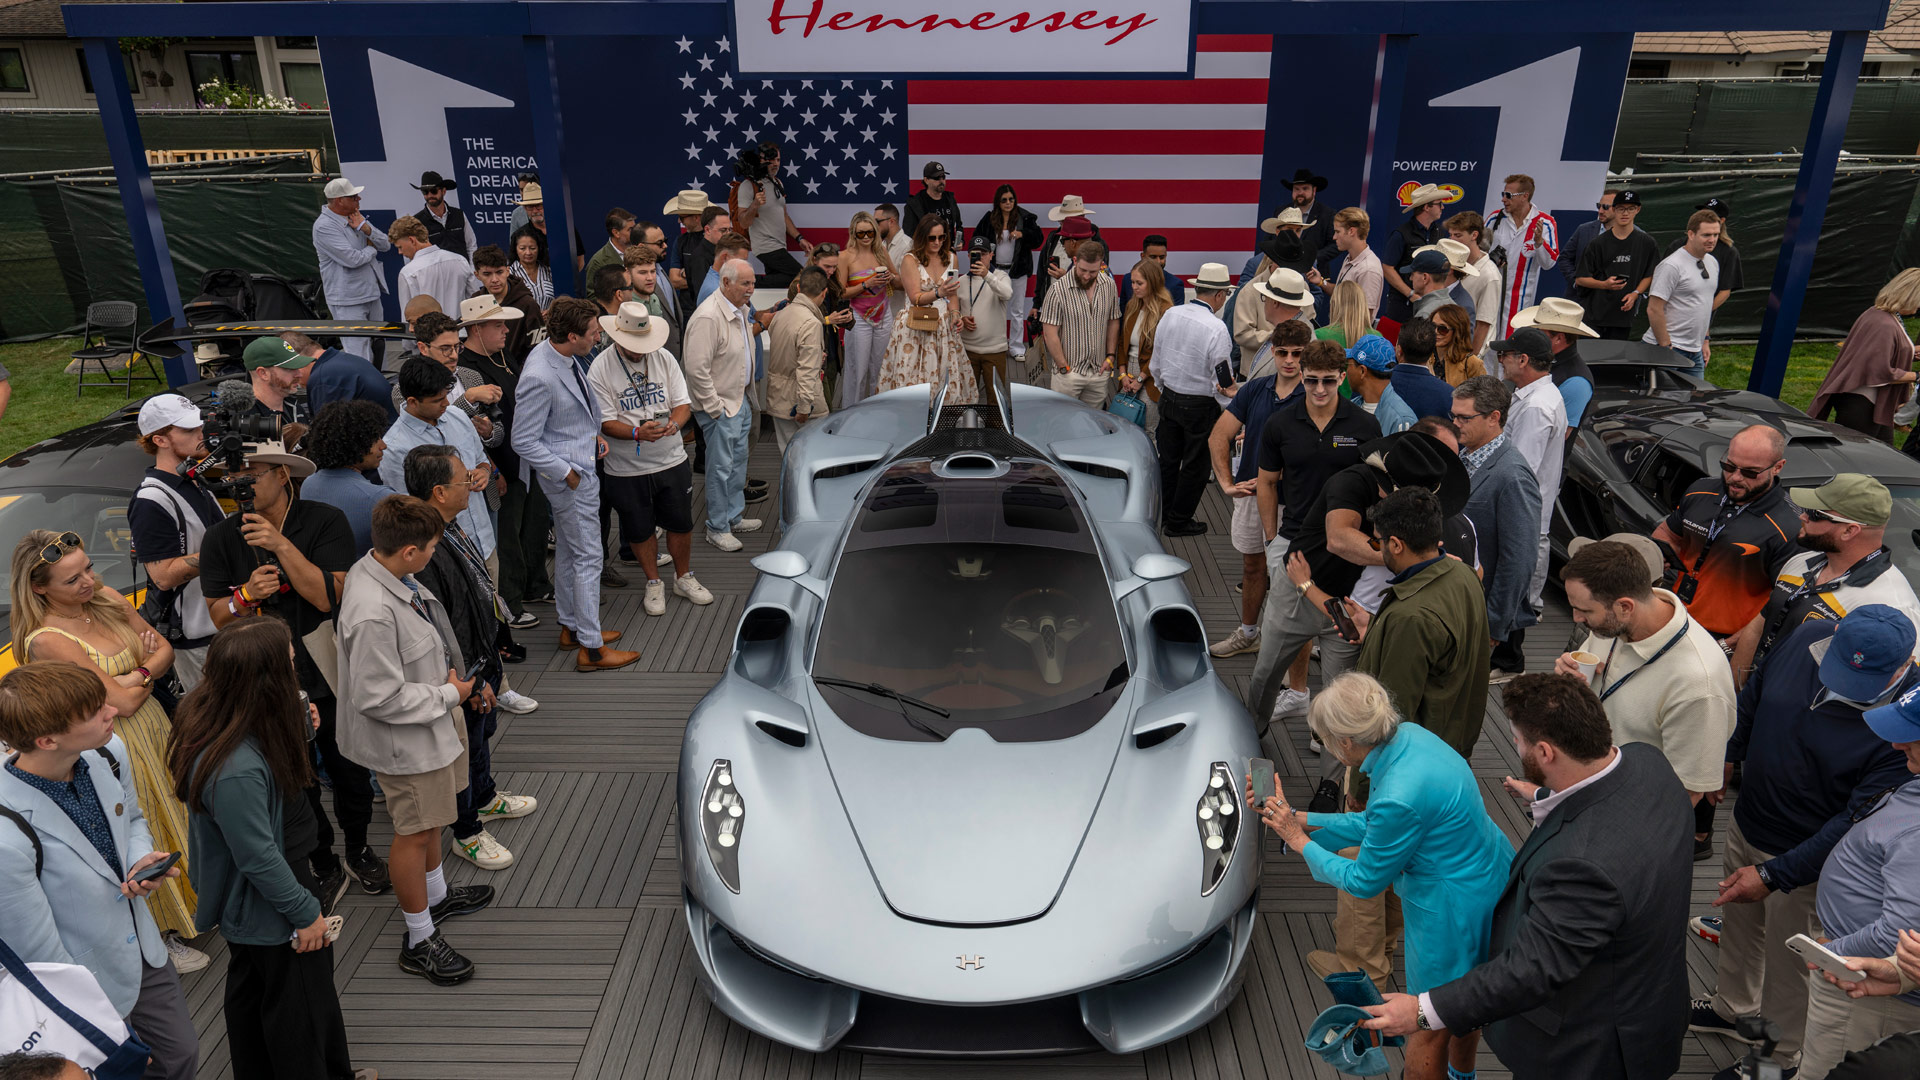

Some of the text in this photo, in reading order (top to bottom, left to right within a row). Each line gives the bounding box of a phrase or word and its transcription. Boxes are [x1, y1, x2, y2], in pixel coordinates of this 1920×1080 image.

[767, 0, 1159, 46] Hennessey
[462, 137, 495, 151] THE
[466, 156, 539, 169] AMERICA
[1392, 160, 1478, 172] POWERED BY
[471, 193, 523, 206] NEVER
[474, 211, 513, 224] SLEE
[619, 389, 667, 412] NIGHTS
[194, 455, 217, 475] RONIN
